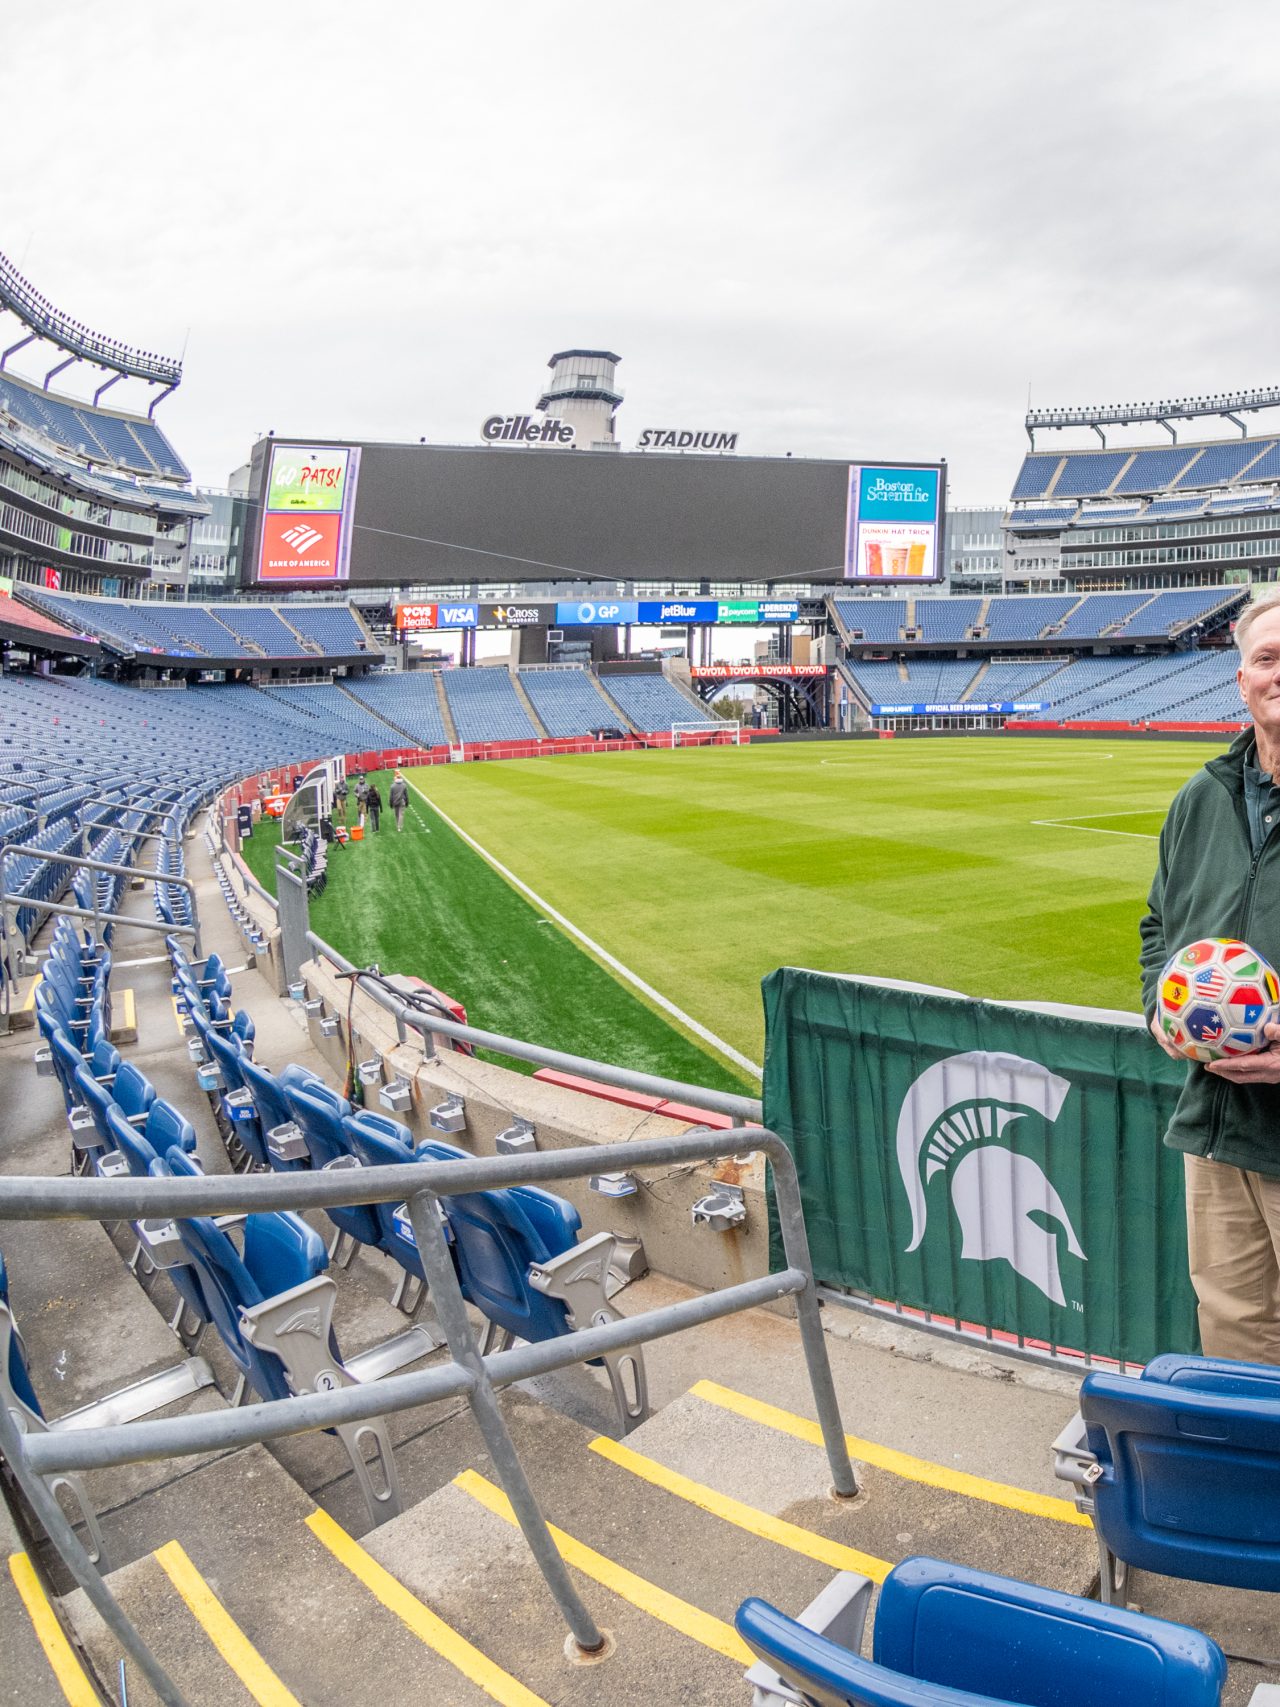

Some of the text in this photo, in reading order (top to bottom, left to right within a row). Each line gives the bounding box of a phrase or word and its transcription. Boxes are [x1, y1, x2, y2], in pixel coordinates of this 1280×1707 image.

[483, 416, 574, 442] Gillette
[639, 430, 737, 450] STADIUM
[275, 466, 342, 489] GO PATS!
[876, 478, 914, 491] Boston
[867, 486, 930, 502] Scientific
[411, 607, 432, 617] CVS
[441, 608, 475, 623] VISA
[661, 605, 696, 619] jetBlue
[728, 609, 757, 617] paycom
[695, 666, 824, 675] TOYOTA TOYOTA TOYOTA TOYOTA
[925, 704, 950, 712] OFFICIAL
[1071, 1300, 1083, 1313] TM
[322, 1377, 334, 1390] 2
